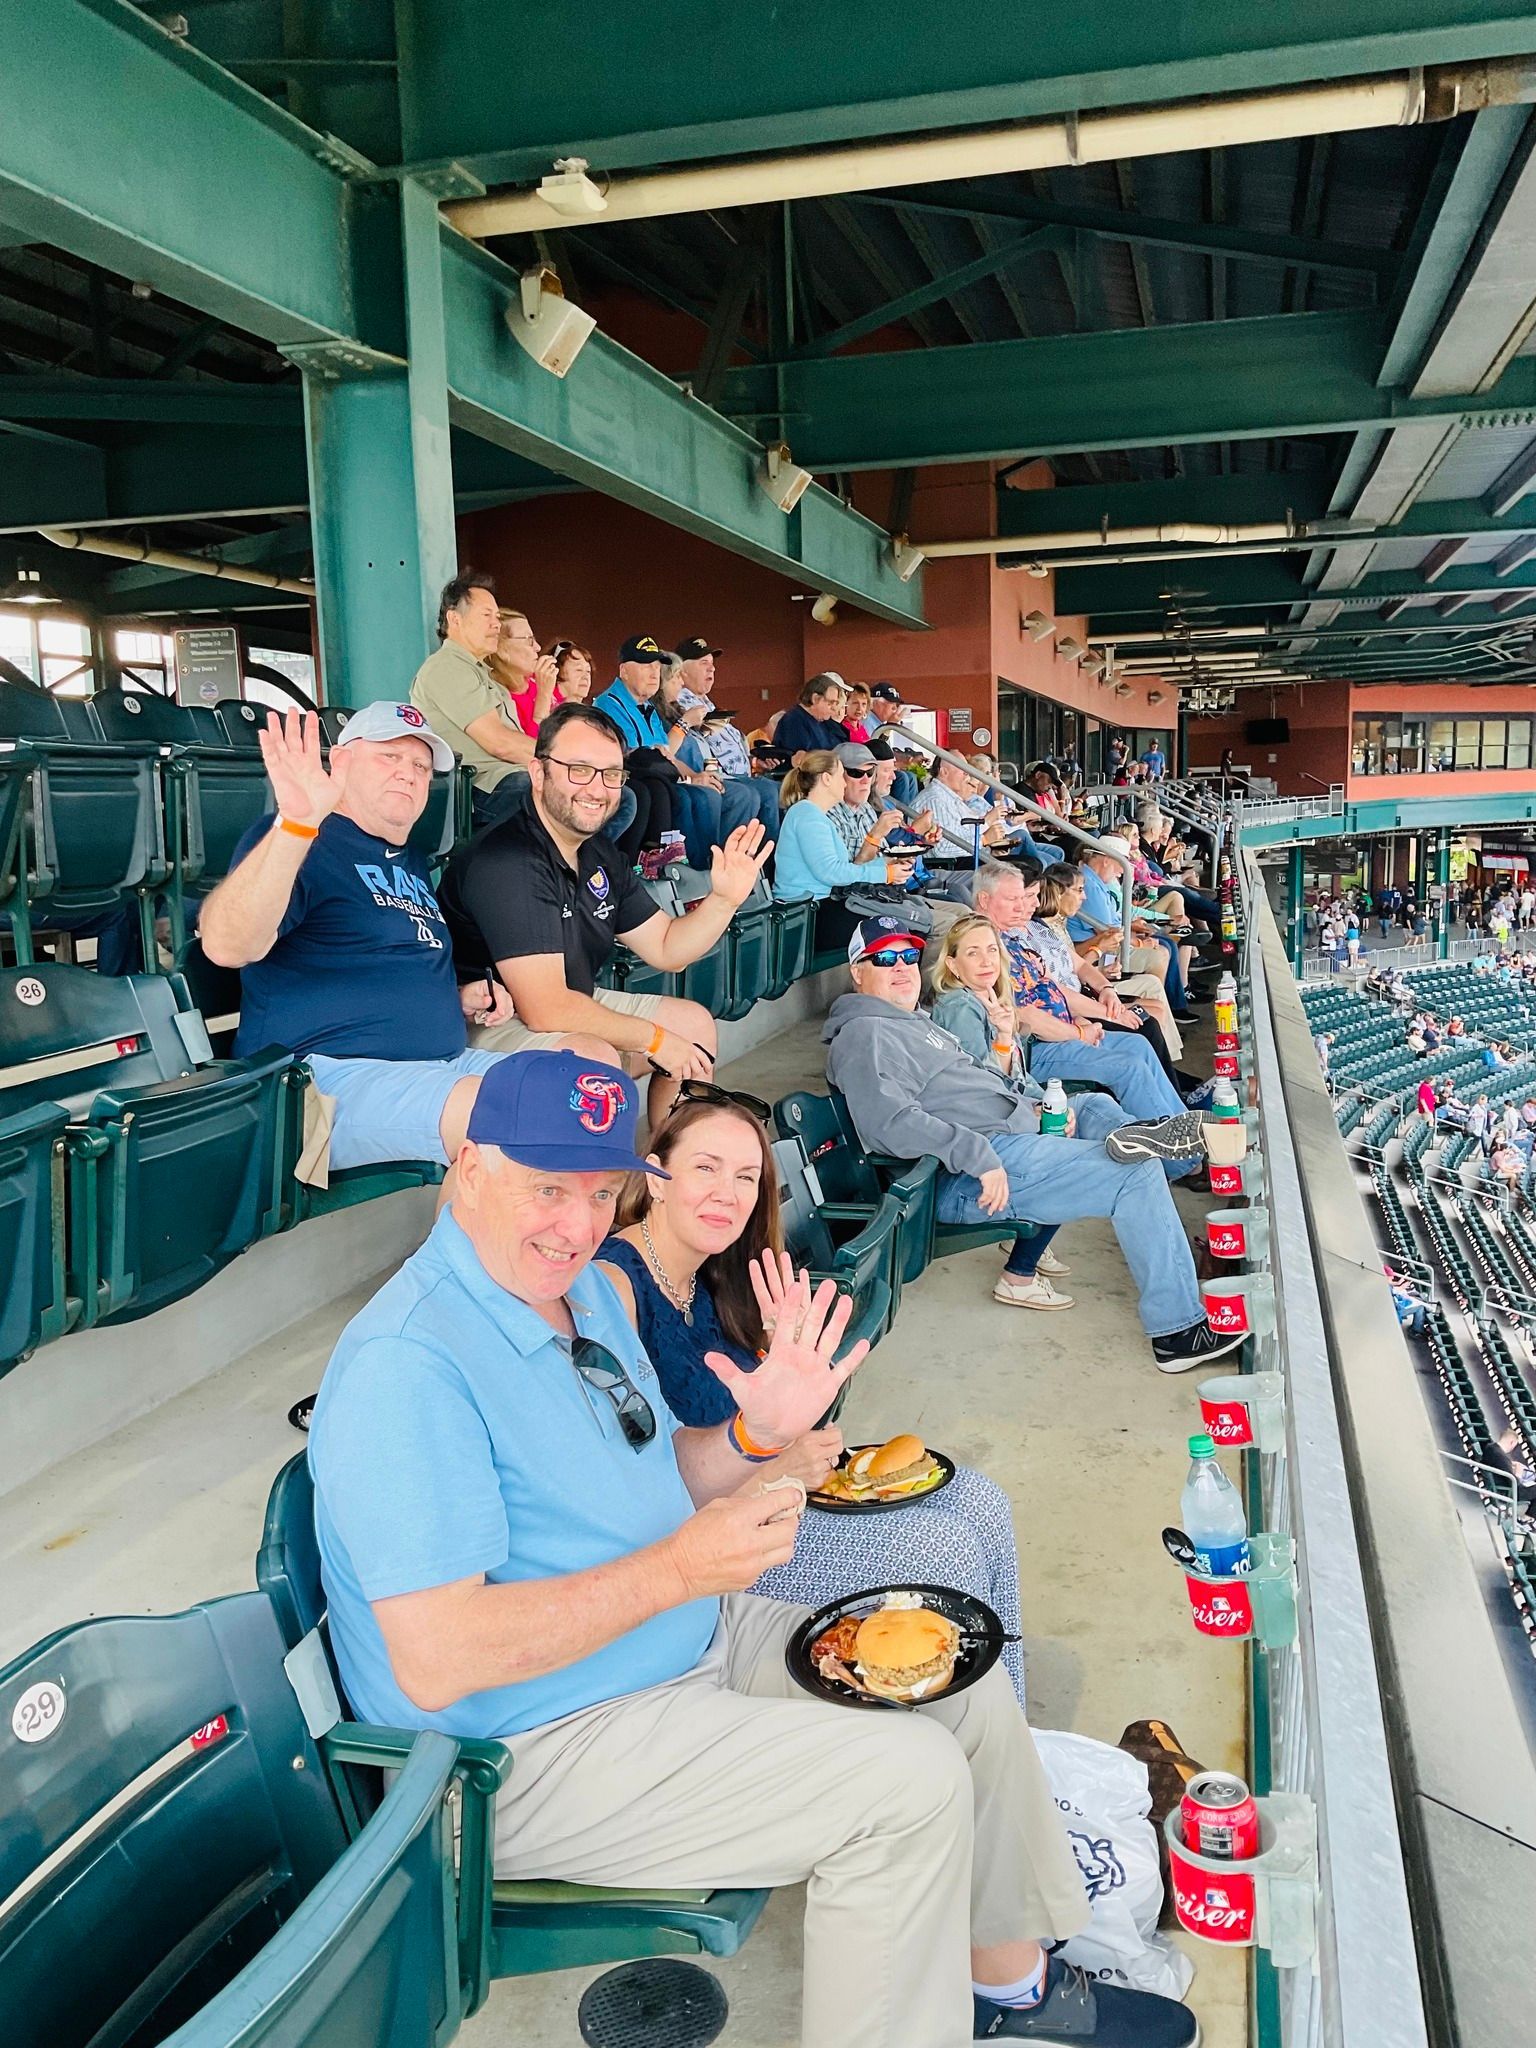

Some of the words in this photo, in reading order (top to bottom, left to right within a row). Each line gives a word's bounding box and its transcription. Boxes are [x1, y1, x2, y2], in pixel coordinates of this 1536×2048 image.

[126, 700, 138, 710] 19
[978, 734, 985, 742] 4
[354, 864, 439, 909] RAYS
[373, 894, 435, 920] BASEBALL
[21, 983, 42, 999] 26
[21, 1691, 56, 1735] 29
[1177, 1890, 1246, 1928] eiser
